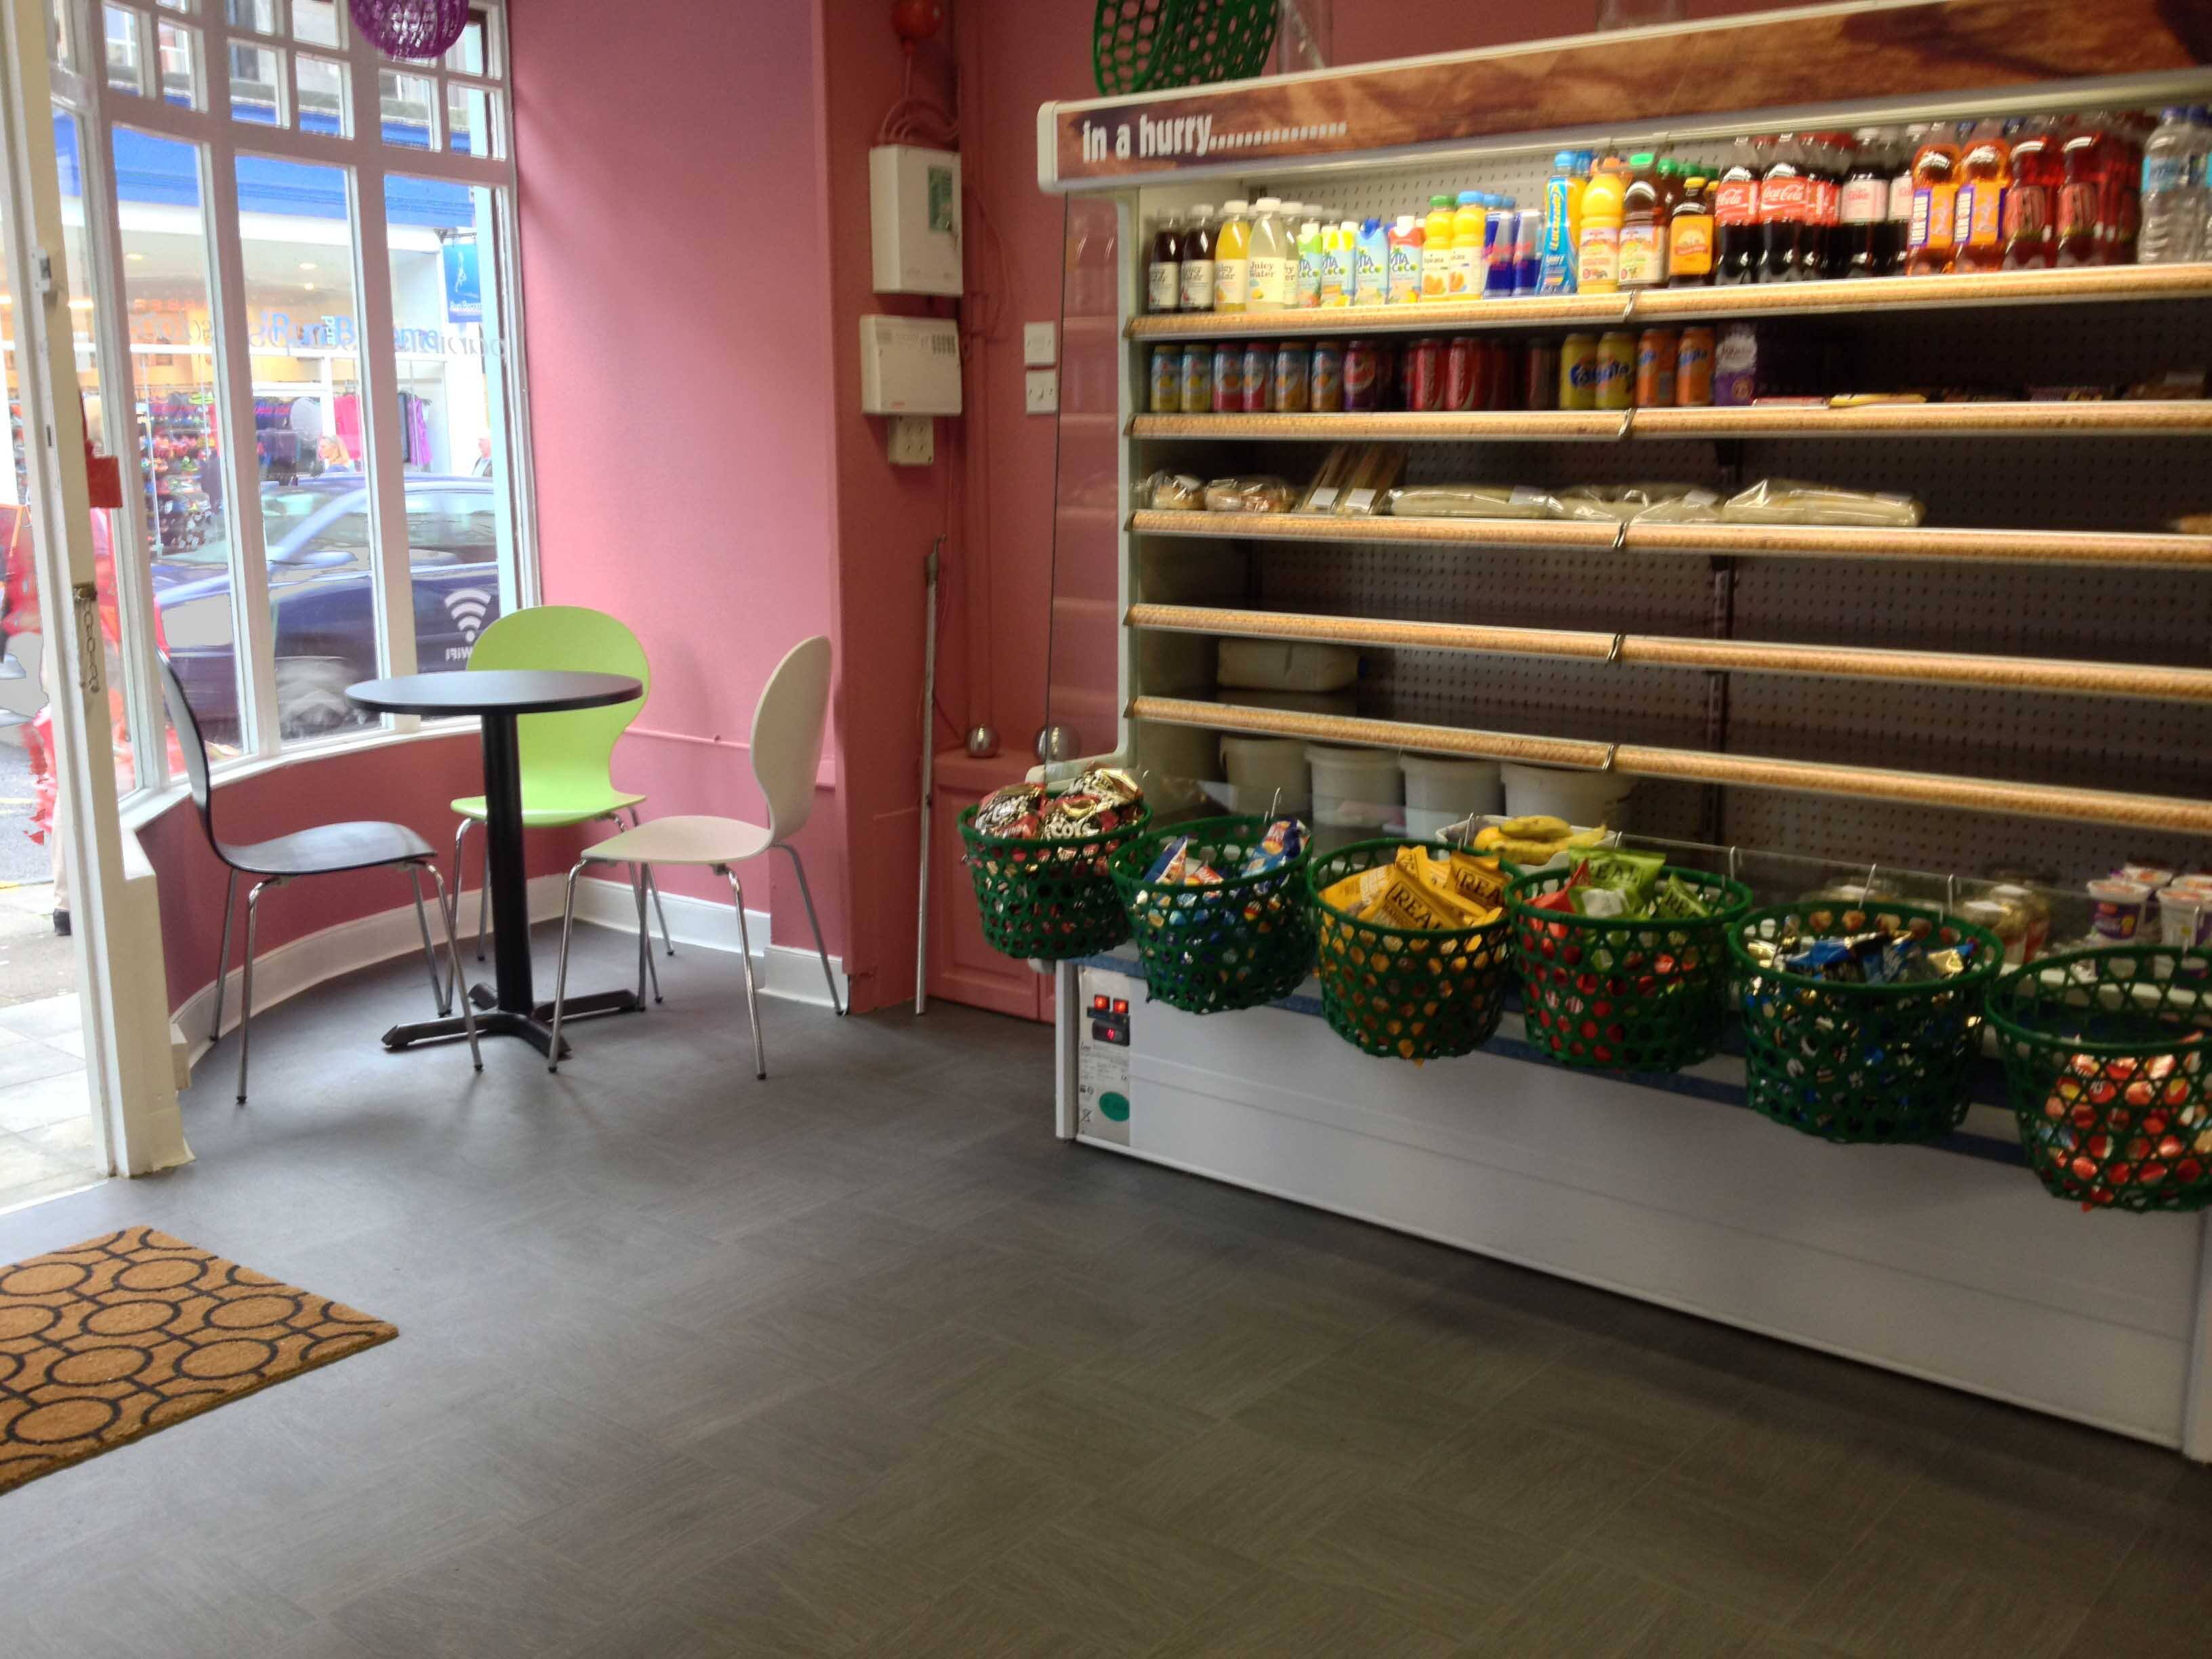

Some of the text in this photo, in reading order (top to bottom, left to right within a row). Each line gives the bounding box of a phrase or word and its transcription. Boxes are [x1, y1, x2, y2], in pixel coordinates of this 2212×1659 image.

[1083, 120, 1107, 163] in
[1115, 123, 1131, 160] a
[1250, 261, 1274, 272] Juicy
[1460, 872, 1502, 906] REA
